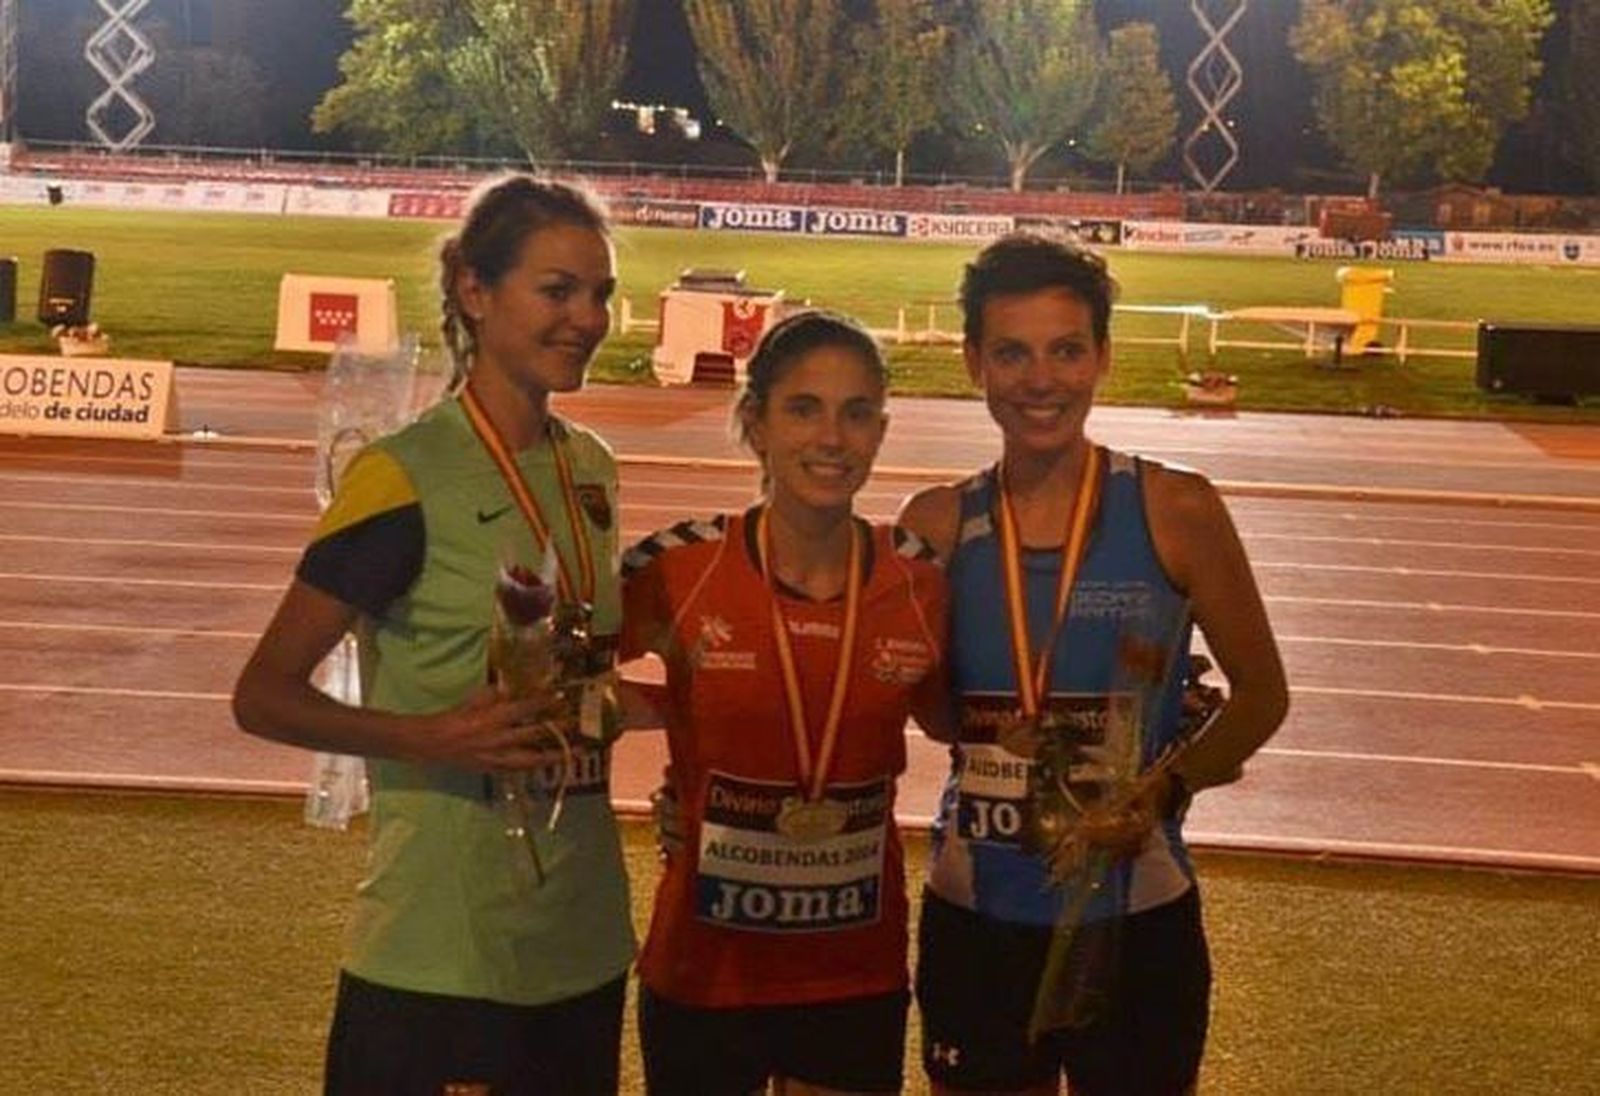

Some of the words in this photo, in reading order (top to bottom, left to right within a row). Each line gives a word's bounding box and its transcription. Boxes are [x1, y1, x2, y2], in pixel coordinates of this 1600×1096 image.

[930, 216, 1011, 237] KYOCERA
[0, 367, 155, 401] OBENDAS
[44, 402, 71, 420] de
[75, 403, 149, 423] ciudad
[970, 801, 1022, 838] JO
[705, 840, 840, 867] ALCOBENDAS
